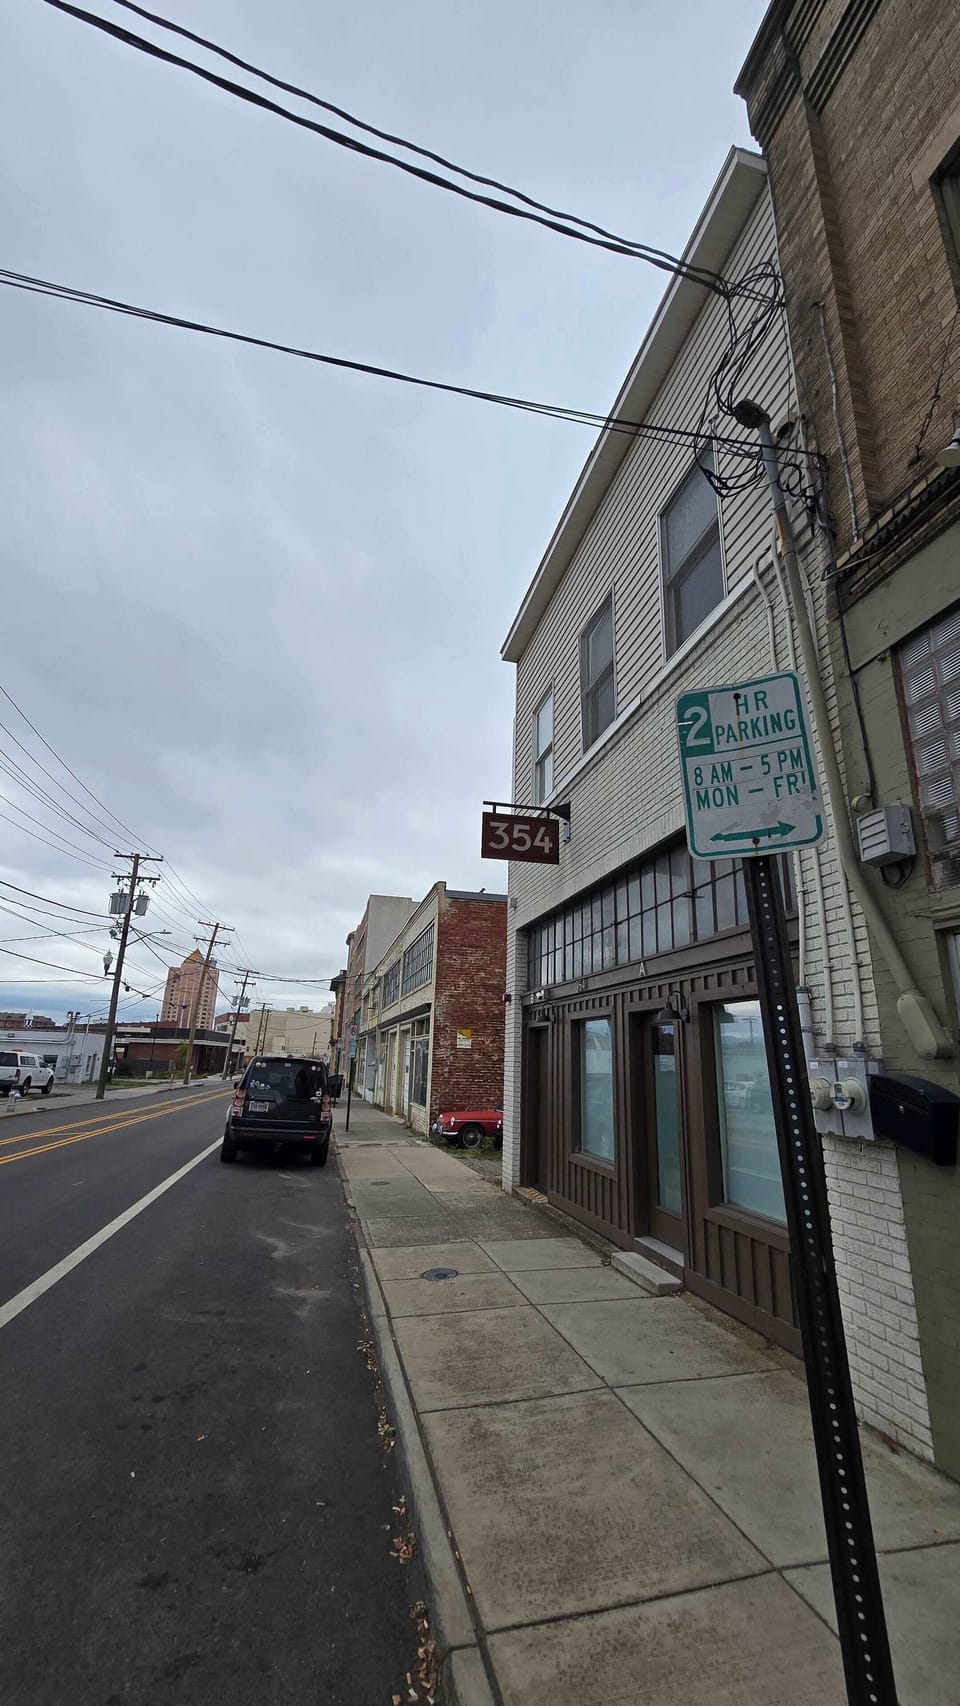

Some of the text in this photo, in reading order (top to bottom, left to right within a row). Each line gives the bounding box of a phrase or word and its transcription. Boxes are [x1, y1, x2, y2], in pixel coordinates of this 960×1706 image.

[683, 690, 769, 747] 2 HR
[714, 709, 796, 745] PARKING
[694, 767, 704, 786] 8
[711, 761, 733, 785] AM
[760, 754, 771, 775] 5
[777, 747, 804, 772] PM
[696, 785, 739, 810] MON
[773, 772, 807, 798] FRI
[489, 822, 553, 853] 354
[639, 961, 646, 977] A
